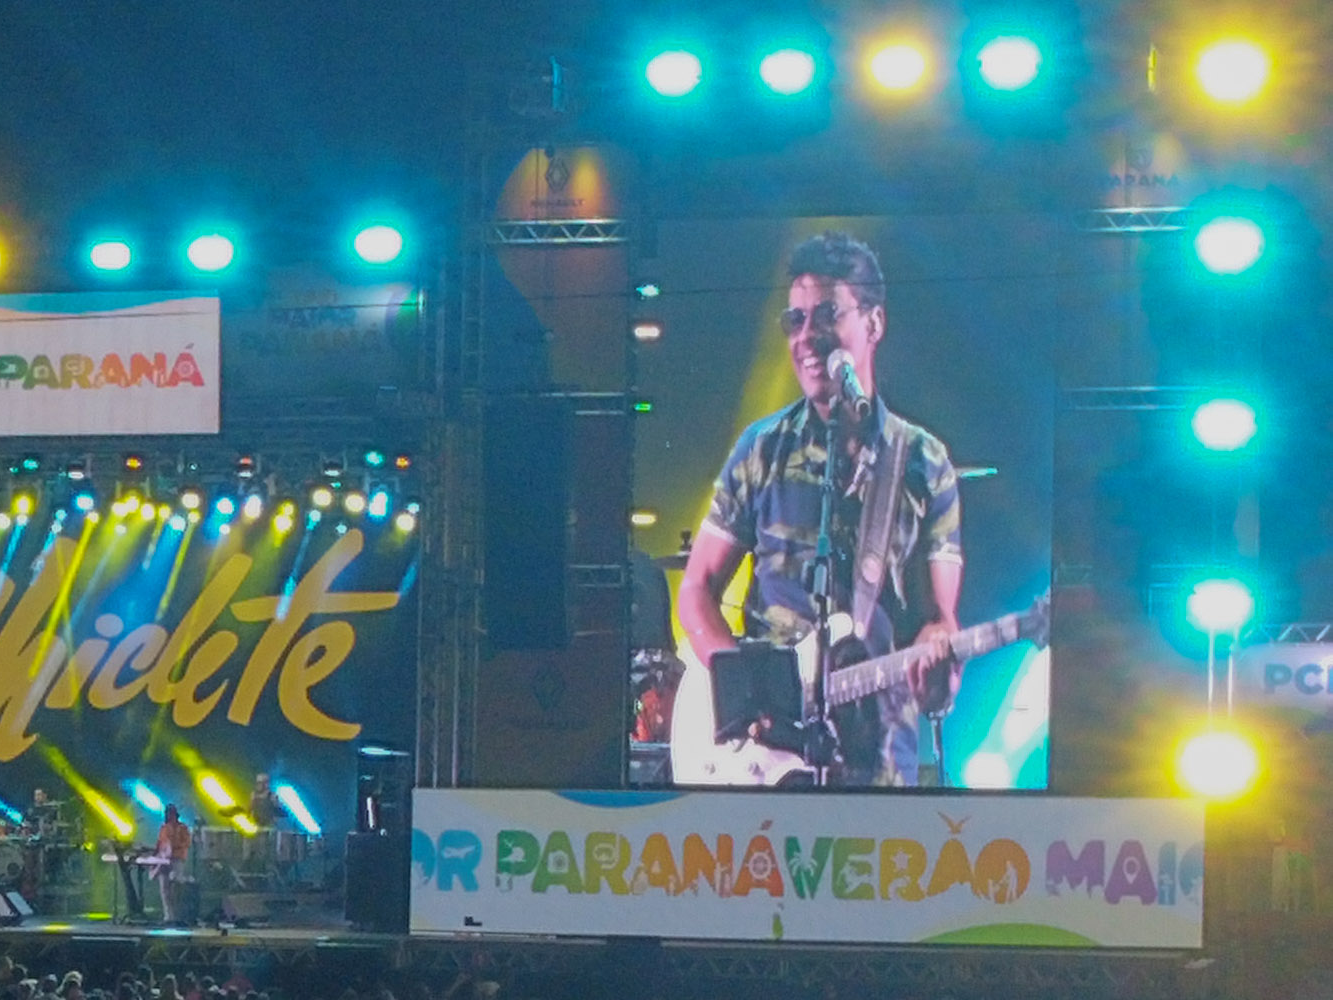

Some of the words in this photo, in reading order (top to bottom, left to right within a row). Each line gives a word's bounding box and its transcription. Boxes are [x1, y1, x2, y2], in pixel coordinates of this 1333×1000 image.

[1264, 663, 1333, 695] PC
[495, 820, 784, 898] PARANÁ
[784, 812, 1031, 905] VERÃO
